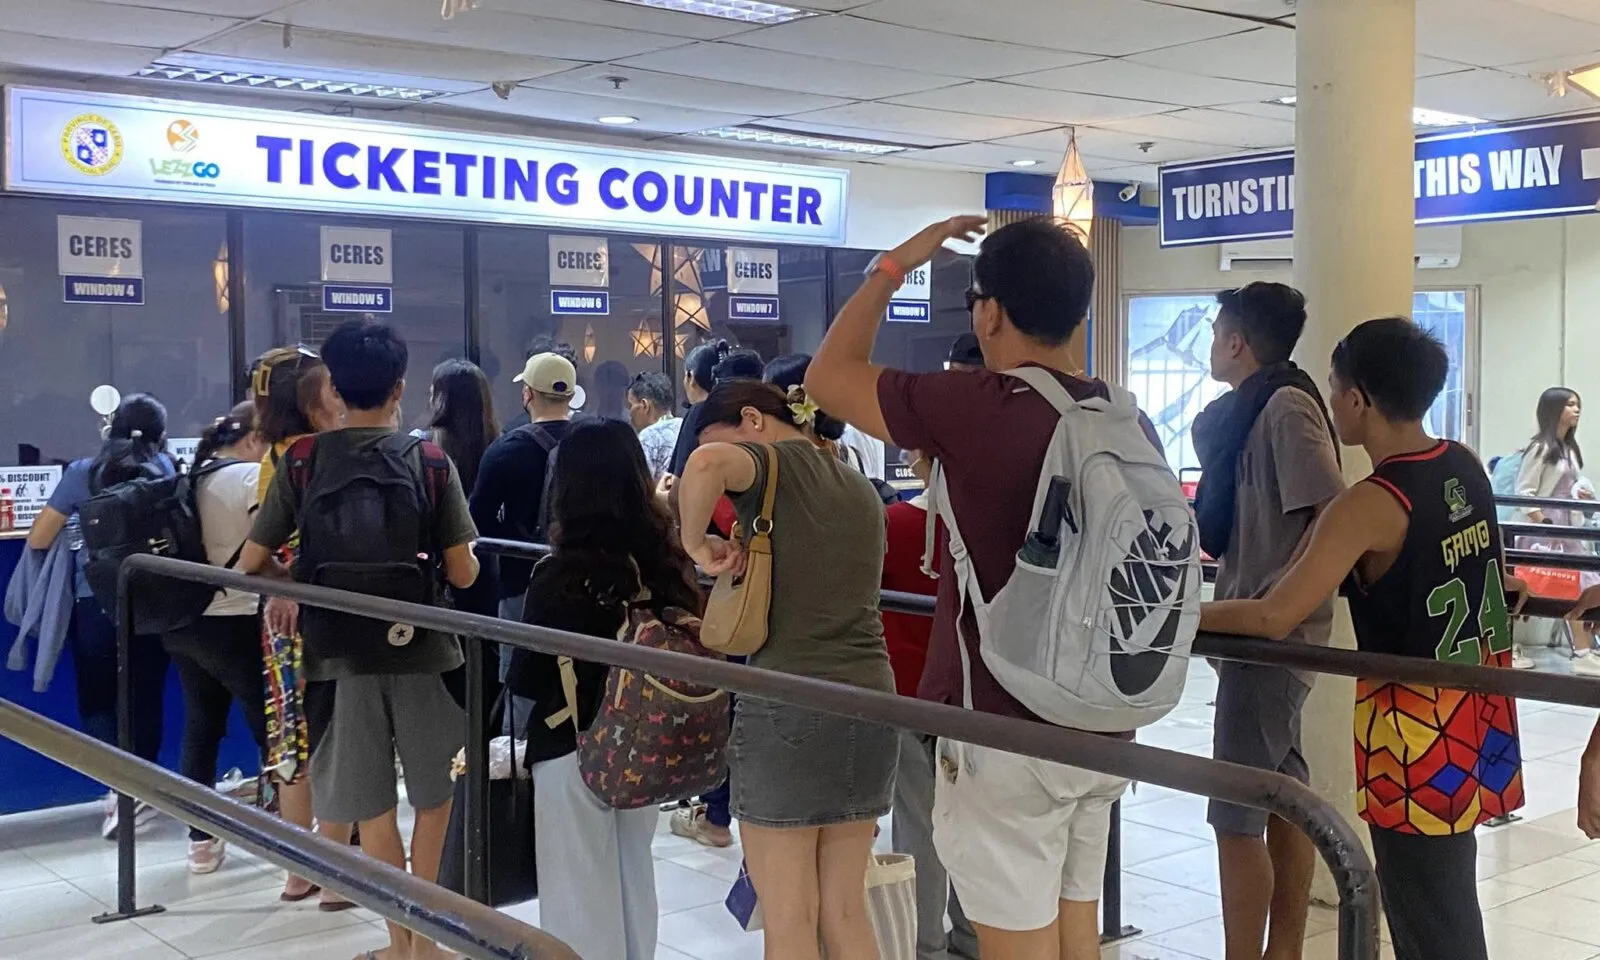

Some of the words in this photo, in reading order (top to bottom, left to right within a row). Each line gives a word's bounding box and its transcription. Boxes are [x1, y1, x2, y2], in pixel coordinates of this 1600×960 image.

[1413, 153, 1481, 199] THIS
[1488, 144, 1564, 191] WAY
[256, 135, 579, 206] TICKETING
[598, 167, 822, 226] COUNTER
[69, 234, 132, 259] CERES
[330, 243, 384, 265] CERES
[557, 250, 602, 270] CERES
[734, 261, 772, 279] CERES
[906, 270, 926, 285] RES
[73, 282, 125, 296] WINDOW
[126, 284, 135, 297] 4
[331, 292, 376, 305] WINDOW
[376, 293, 384, 305] 5
[558, 296, 595, 309] WINDOW
[595, 297, 602, 309] 6
[736, 302, 768, 315] WINDOW
[768, 303, 773, 314] 7
[892, 306, 920, 317] WINDOW
[7, 472, 51, 483] DISCOUNT
[895, 467, 915, 478] CLOS
[1441, 520, 1490, 574] GAMO
[1426, 558, 1511, 666] 24
